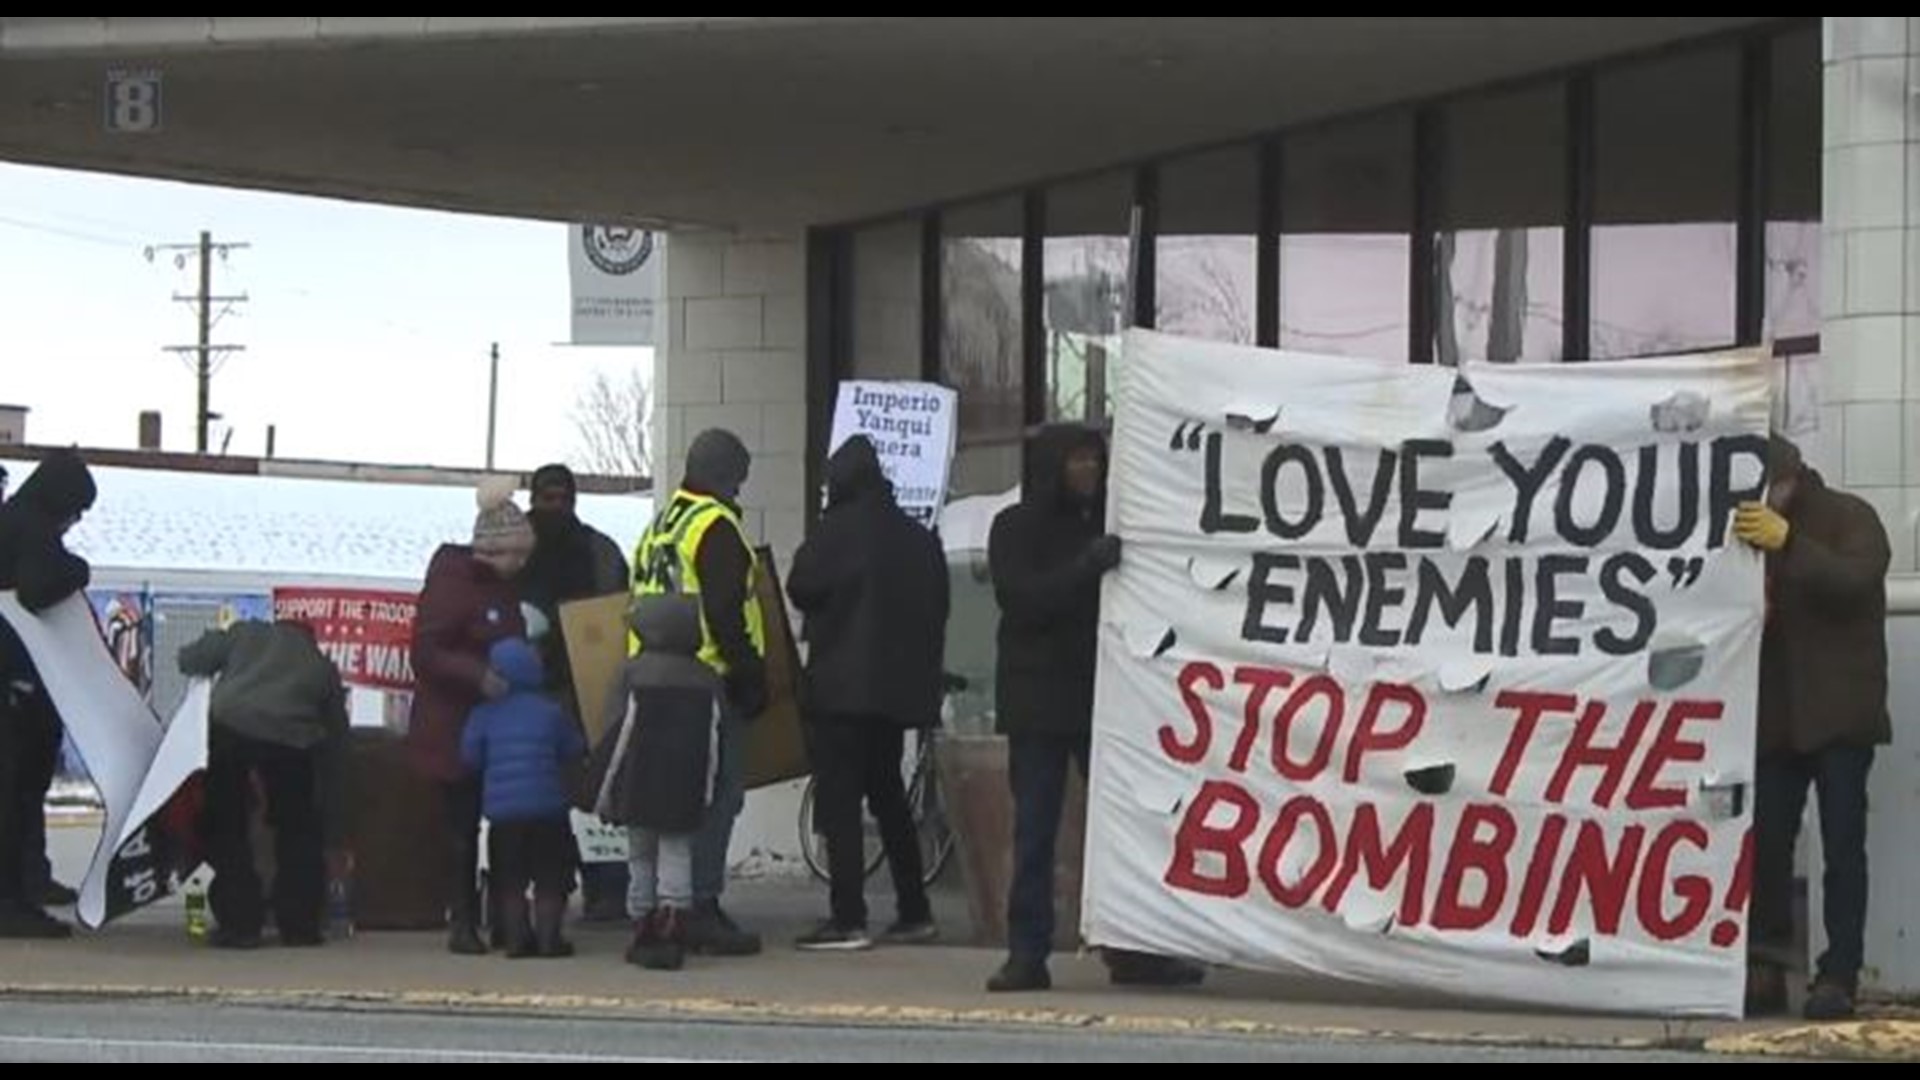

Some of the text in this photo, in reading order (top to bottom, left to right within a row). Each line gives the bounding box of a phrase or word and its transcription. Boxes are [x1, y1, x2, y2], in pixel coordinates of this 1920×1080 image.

[853, 386, 941, 414] Imperio
[856, 408, 932, 439] Yanqui
[869, 434, 922, 458] uera
[338, 598, 365, 620] THE
[1158, 661, 1725, 811] STOP THE
[1164, 779, 1756, 948] BOMBING!
